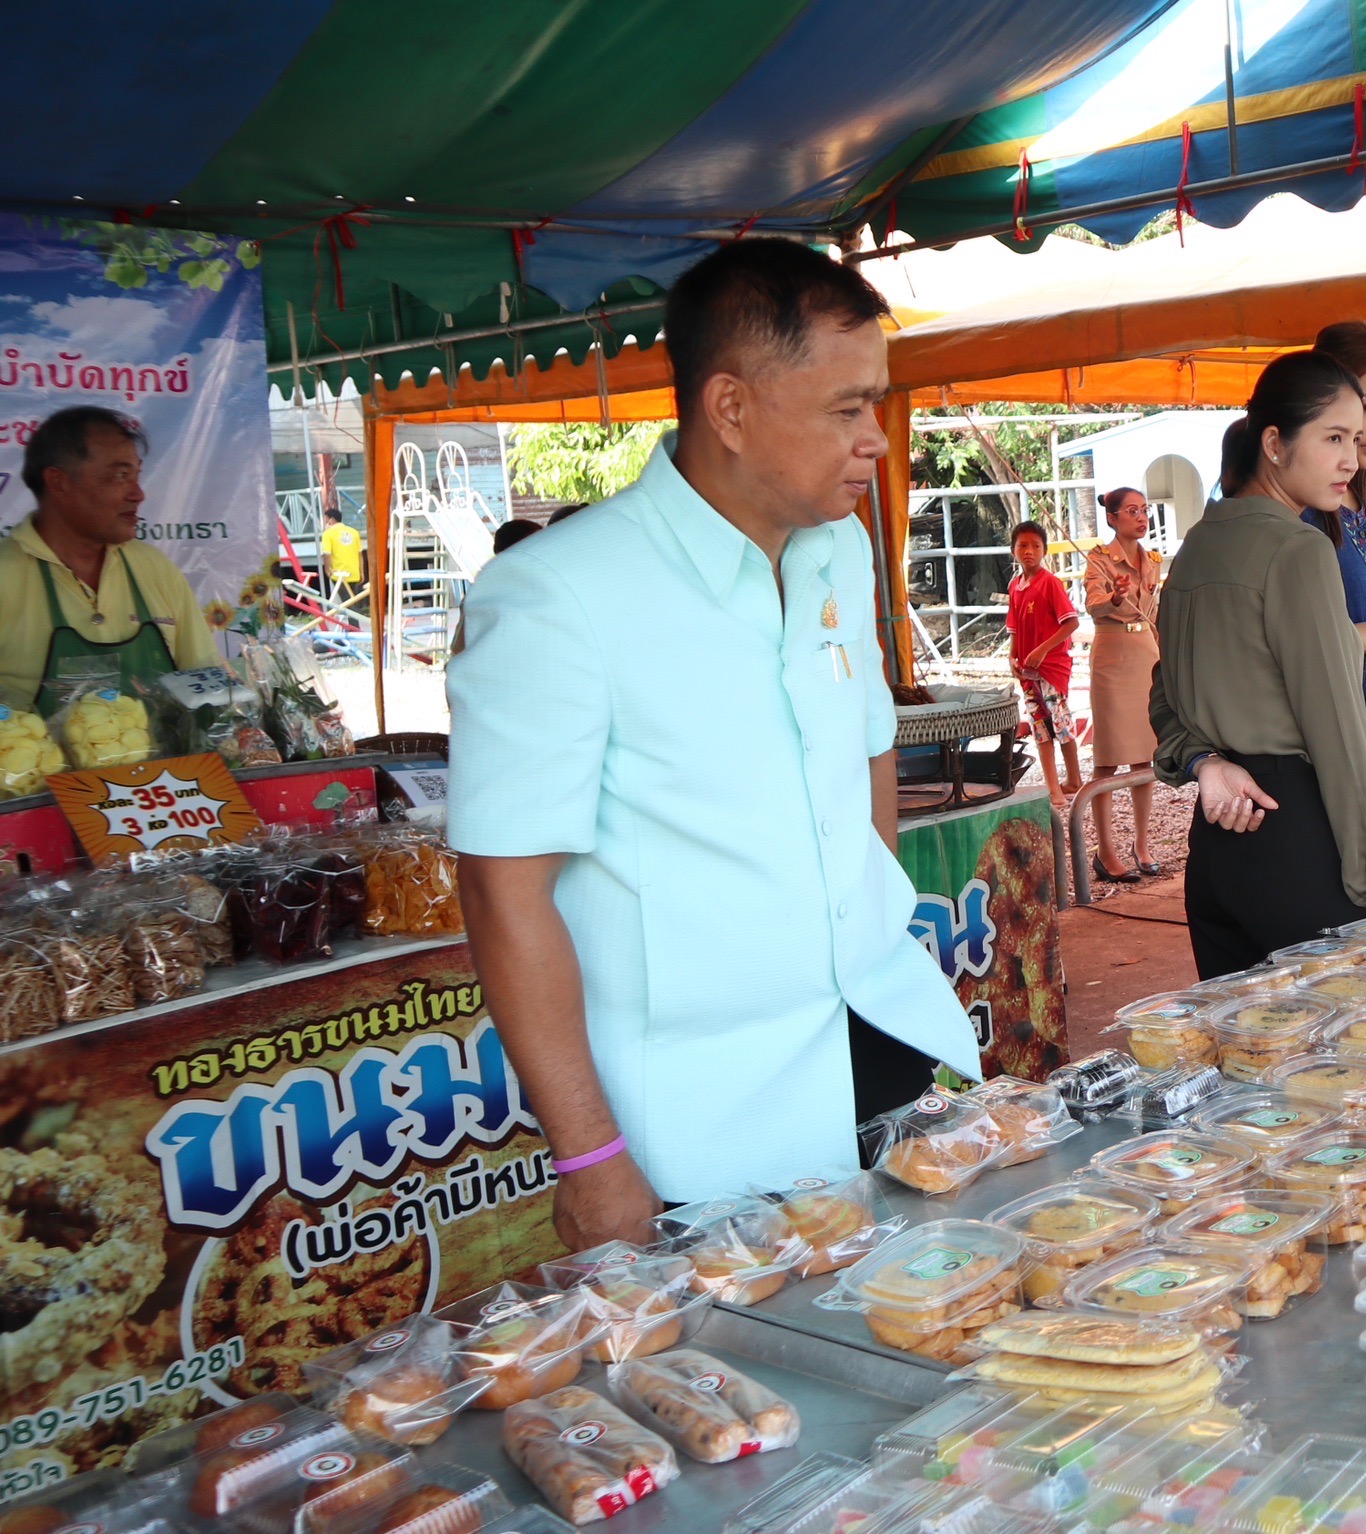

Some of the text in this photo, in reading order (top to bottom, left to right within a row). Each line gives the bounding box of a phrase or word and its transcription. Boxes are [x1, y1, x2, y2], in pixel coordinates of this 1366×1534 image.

[132, 785, 176, 811] 35
[122, 817, 143, 837] 3
[168, 806, 216, 829] 100
[159, 1026, 530, 1215] ขนม
